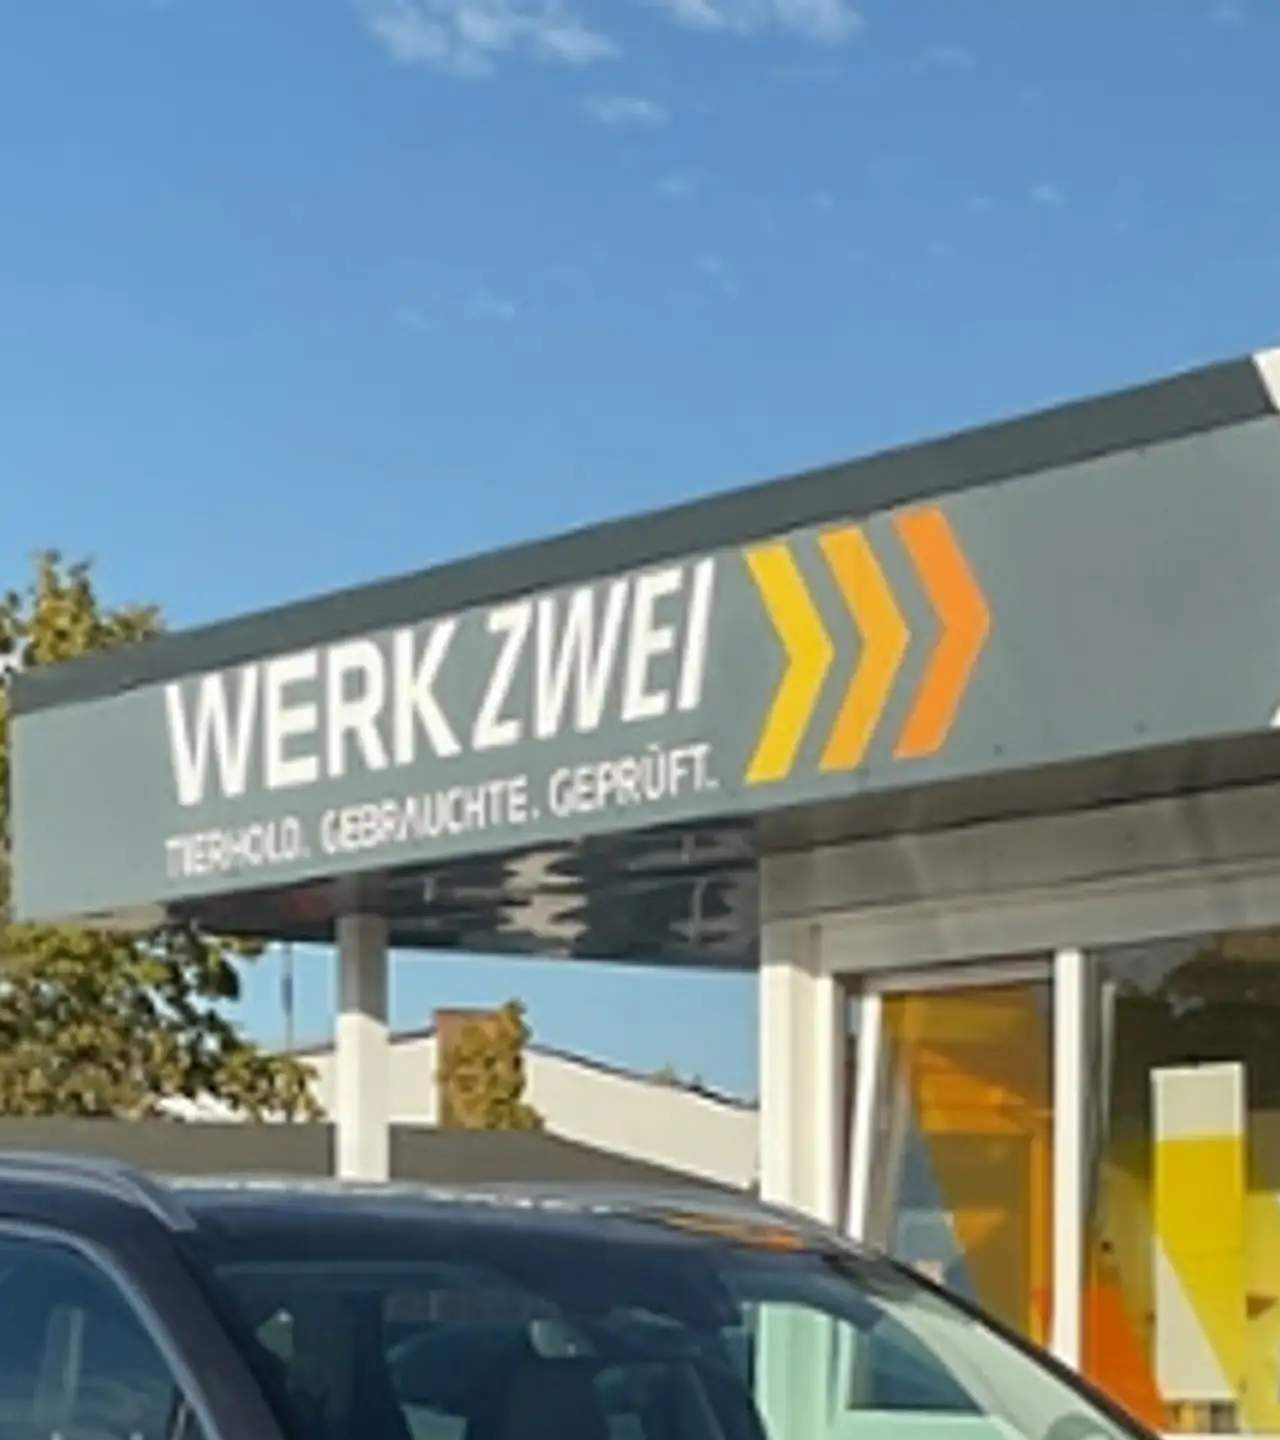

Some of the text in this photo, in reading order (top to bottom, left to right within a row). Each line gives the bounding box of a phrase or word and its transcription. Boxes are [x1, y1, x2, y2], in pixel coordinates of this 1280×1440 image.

[164, 558, 715, 806] WERK ZWEI
[165, 742, 719, 878] TIERHOLD. GEBRAUCHTE. GEPRÜFT.
